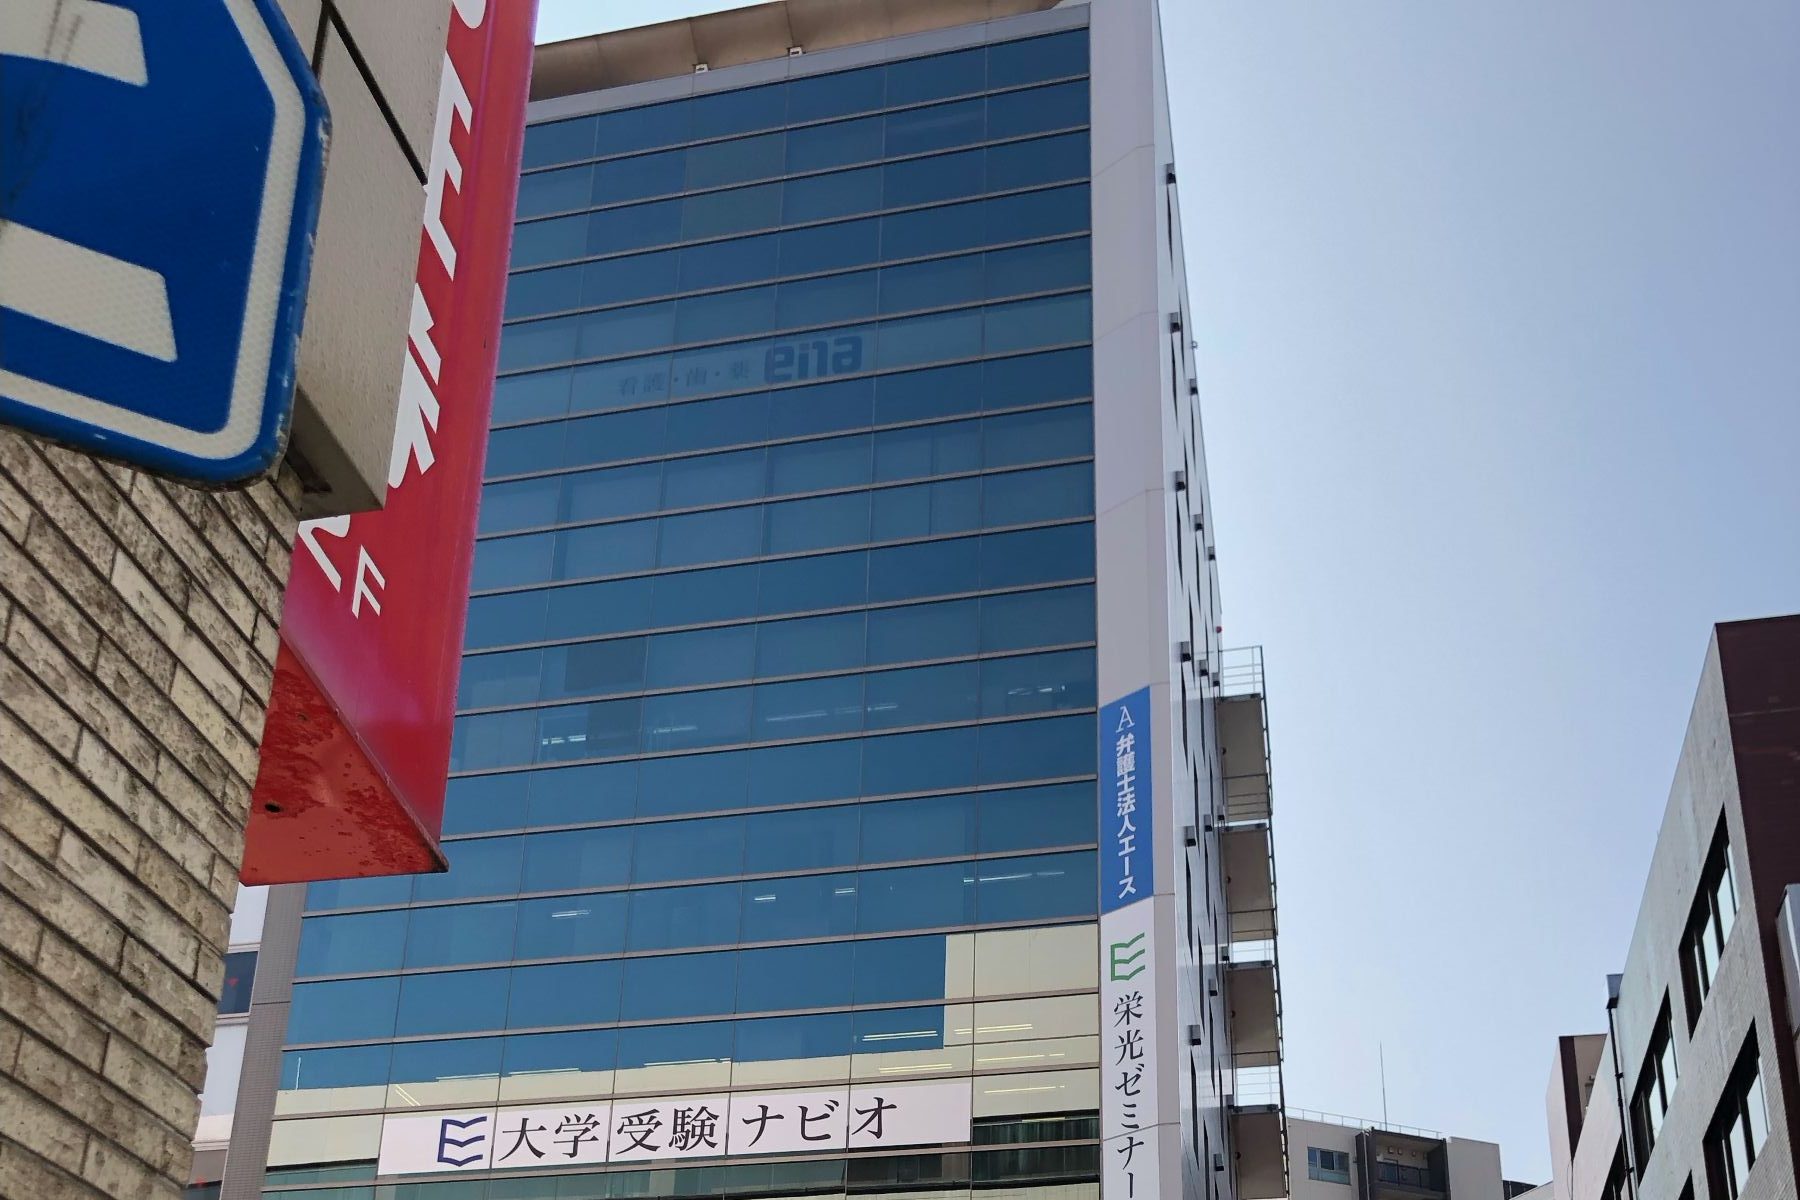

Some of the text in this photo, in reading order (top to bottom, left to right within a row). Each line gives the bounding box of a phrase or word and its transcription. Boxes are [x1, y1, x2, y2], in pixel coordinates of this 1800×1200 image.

[764, 334, 863, 383] ena
[1116, 734, 1137, 899] 弁護士法人エース
[498, 1096, 898, 1161] 大学受験ナビオ
